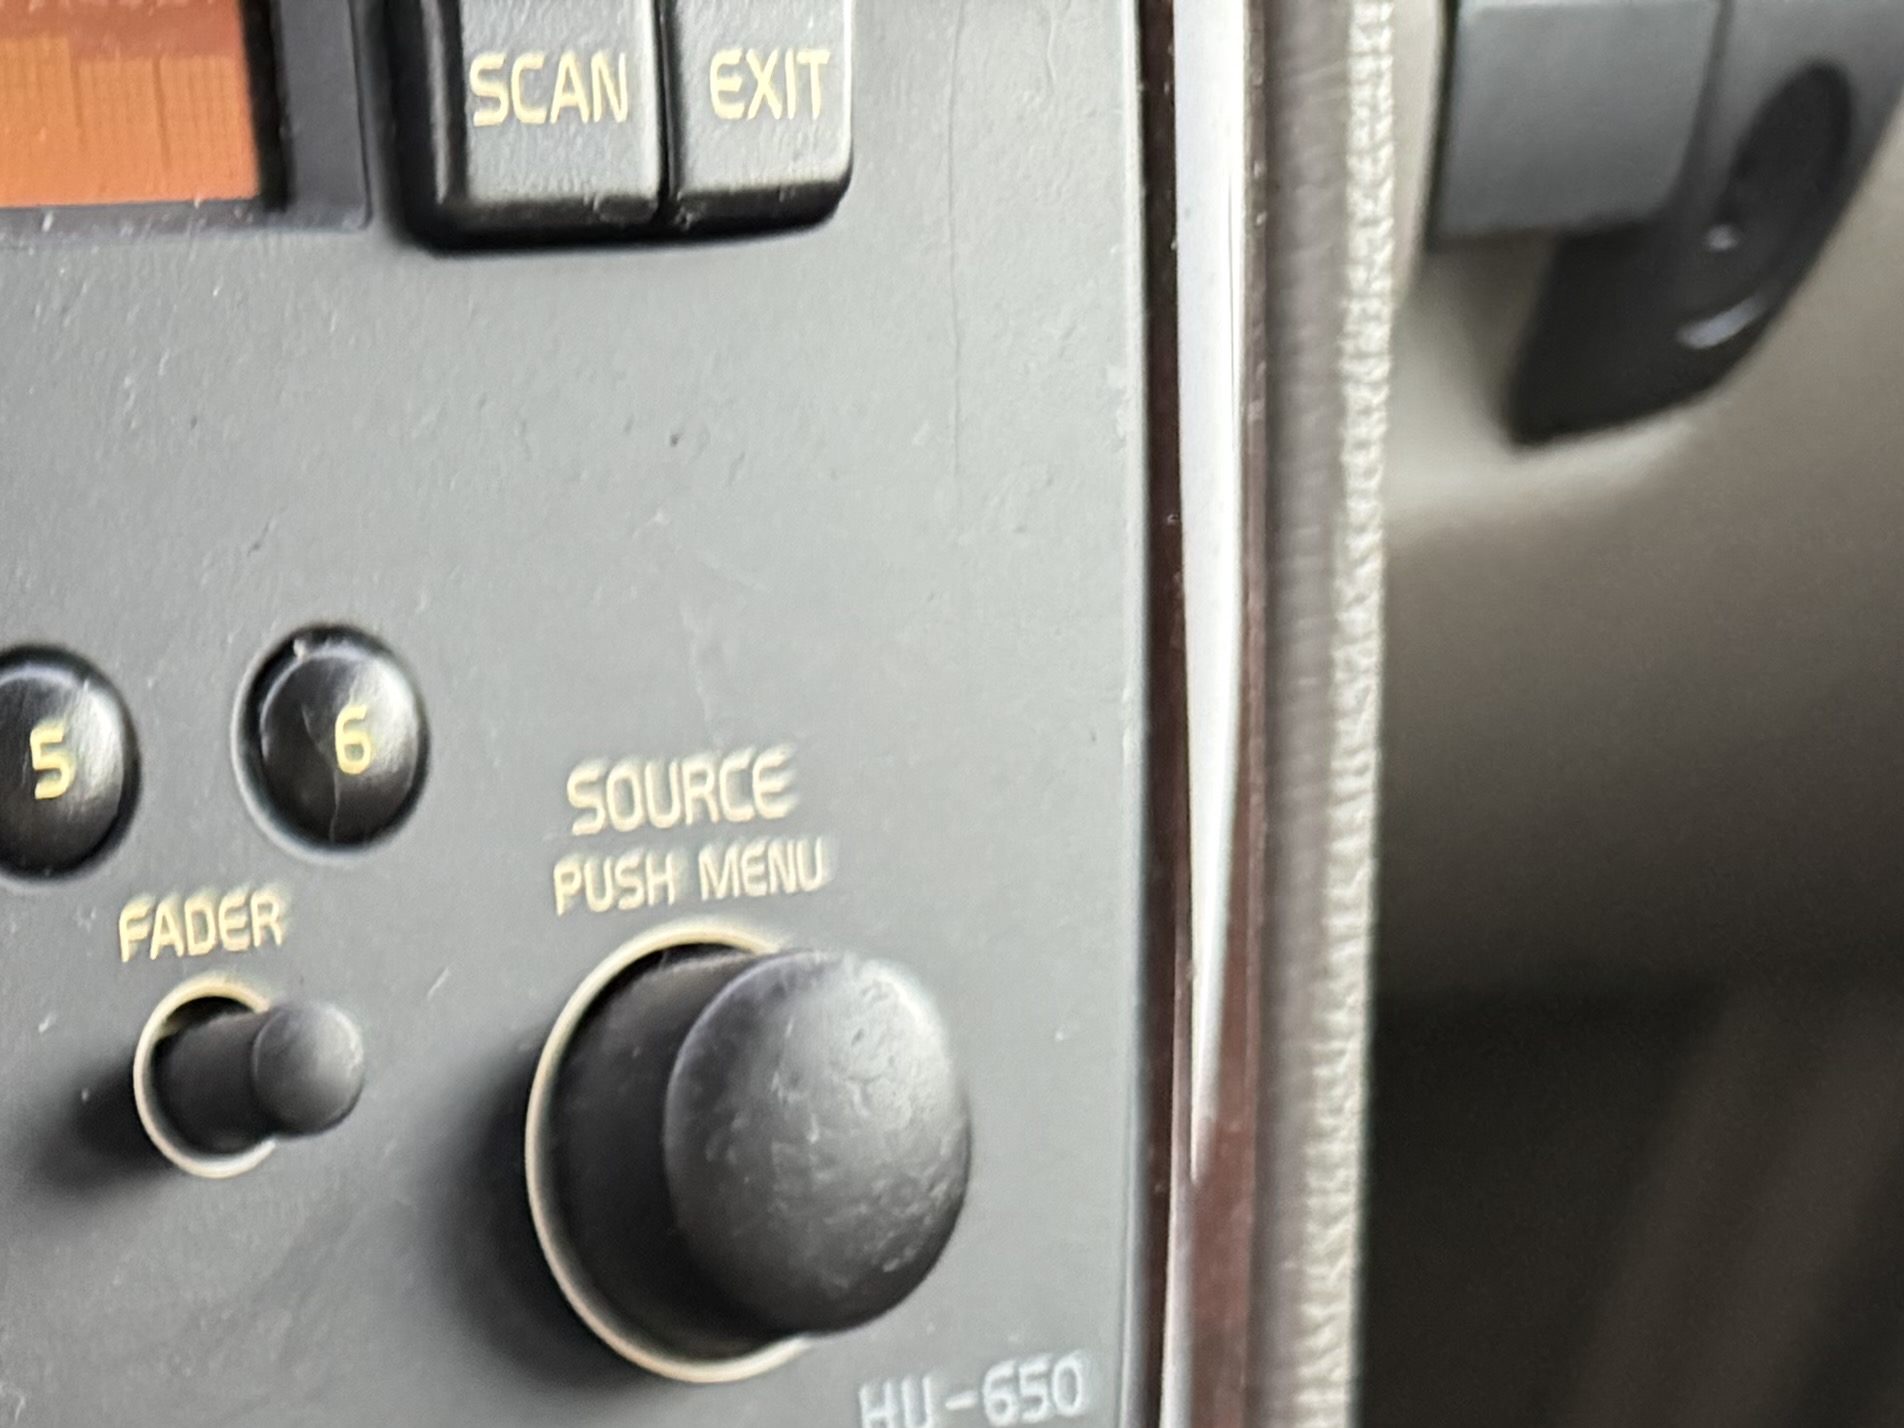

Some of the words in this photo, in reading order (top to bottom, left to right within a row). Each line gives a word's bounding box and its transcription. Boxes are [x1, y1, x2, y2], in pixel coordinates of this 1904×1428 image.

[469, 50, 629, 128] SCAN
[709, 45, 830, 122] EXIT
[29, 727, 75, 801] 5
[334, 704, 373, 774] 6
[567, 745, 797, 836] SOURCE
[553, 851, 677, 916] PUSH
[698, 838, 832, 900] MENU
[119, 889, 290, 963] FADER
